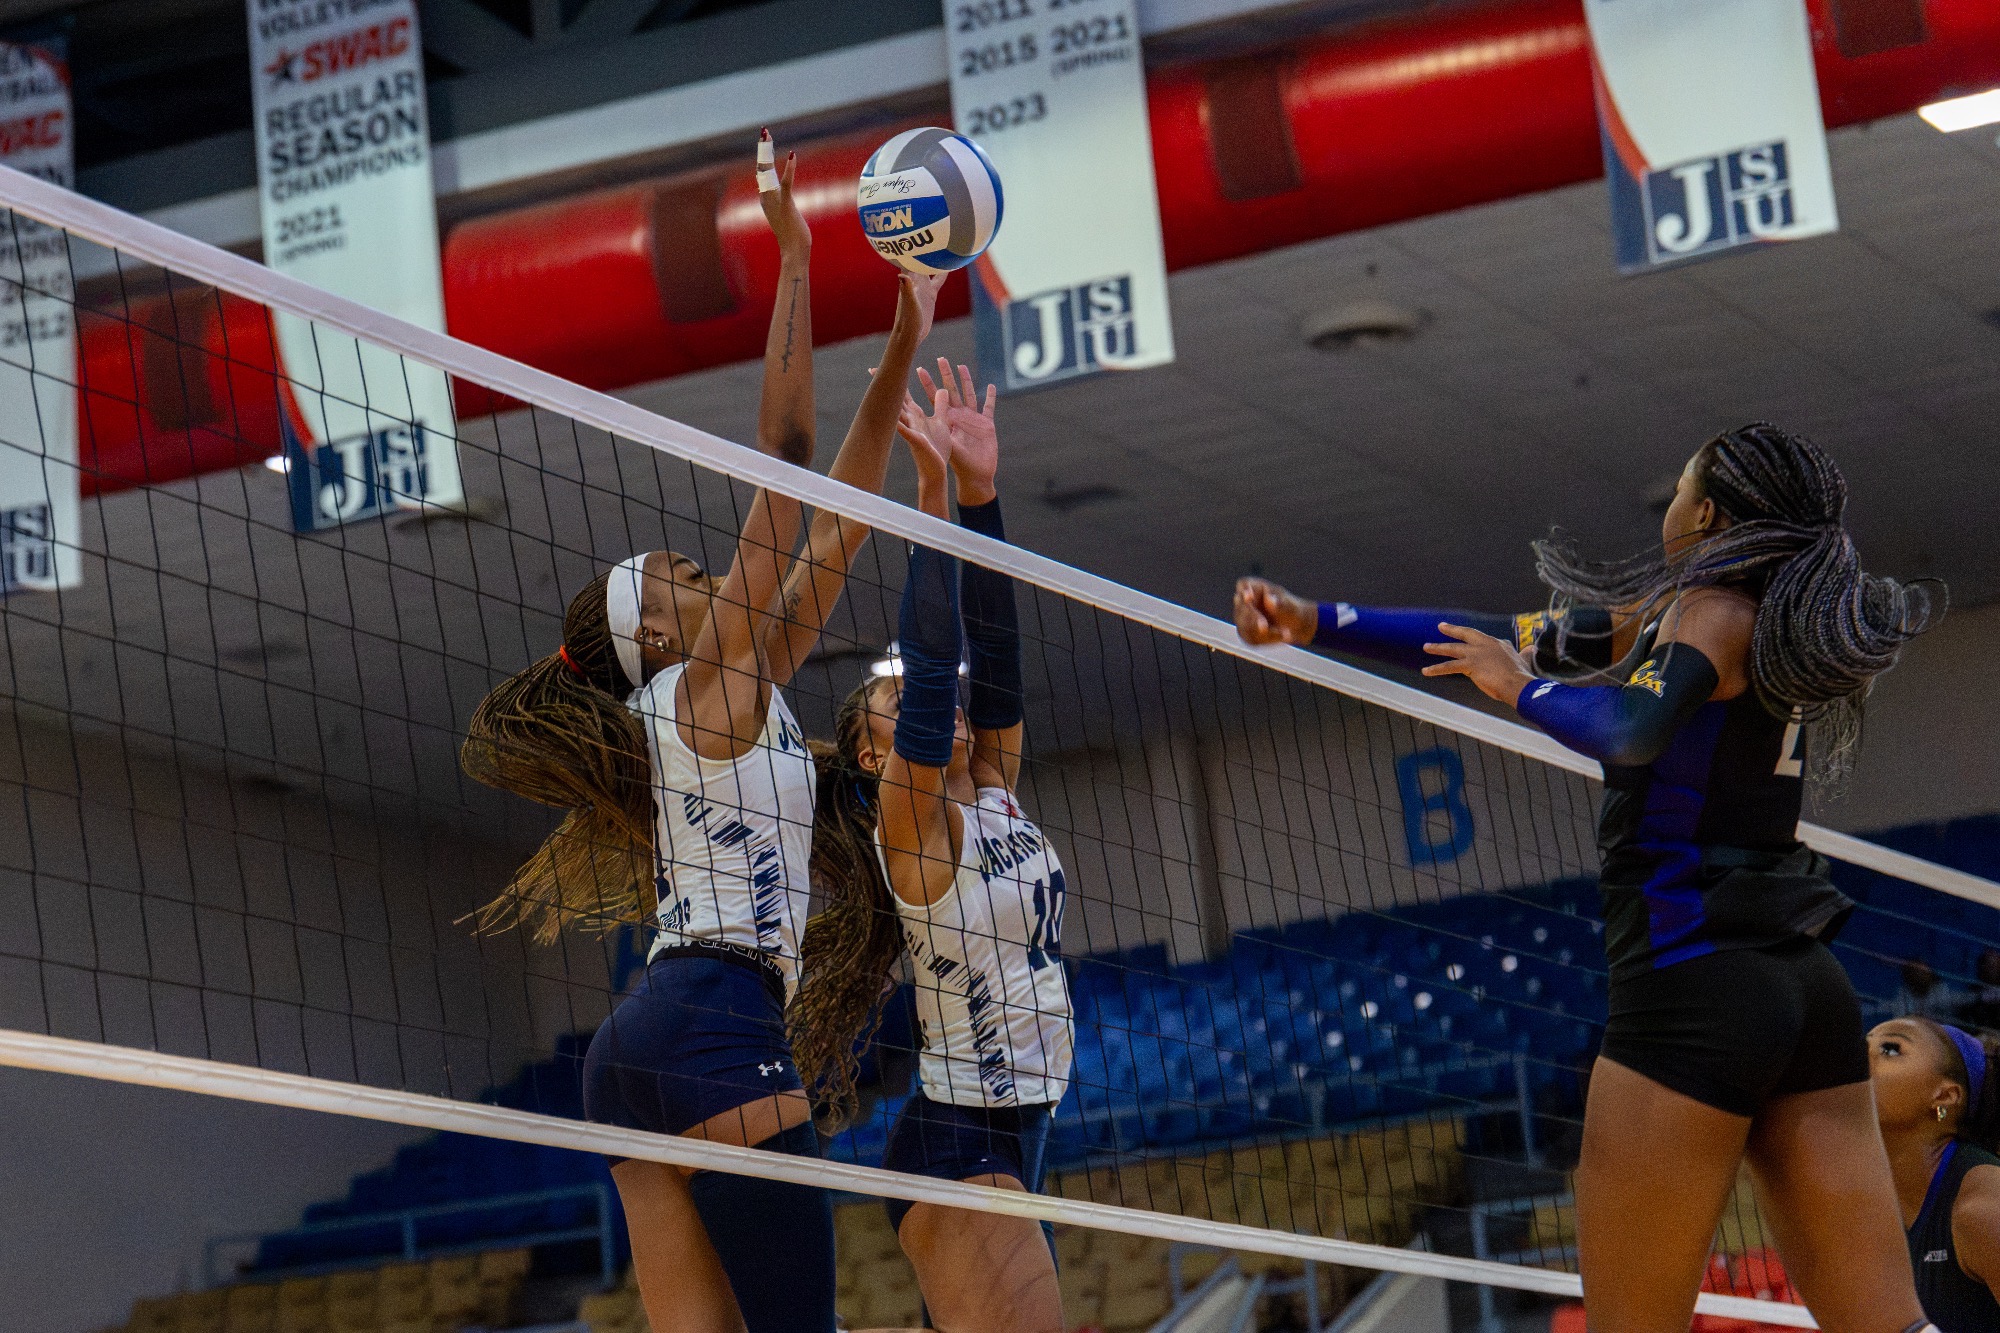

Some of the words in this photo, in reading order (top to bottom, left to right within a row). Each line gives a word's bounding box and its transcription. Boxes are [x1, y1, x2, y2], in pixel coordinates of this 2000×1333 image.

[302, 16, 410, 82] SWAC
[960, 32, 1039, 77] 2015
[1051, 11, 1128, 53] 2021
[265, 70, 417, 138] REGULAR
[967, 90, 1047, 136] 2023
[269, 104, 420, 175] SEASON
[270, 143, 422, 203] CHAMPIONS
[275, 203, 344, 244] 2021
[863, 207, 914, 233] NCAA
[1394, 746, 1475, 868] B
